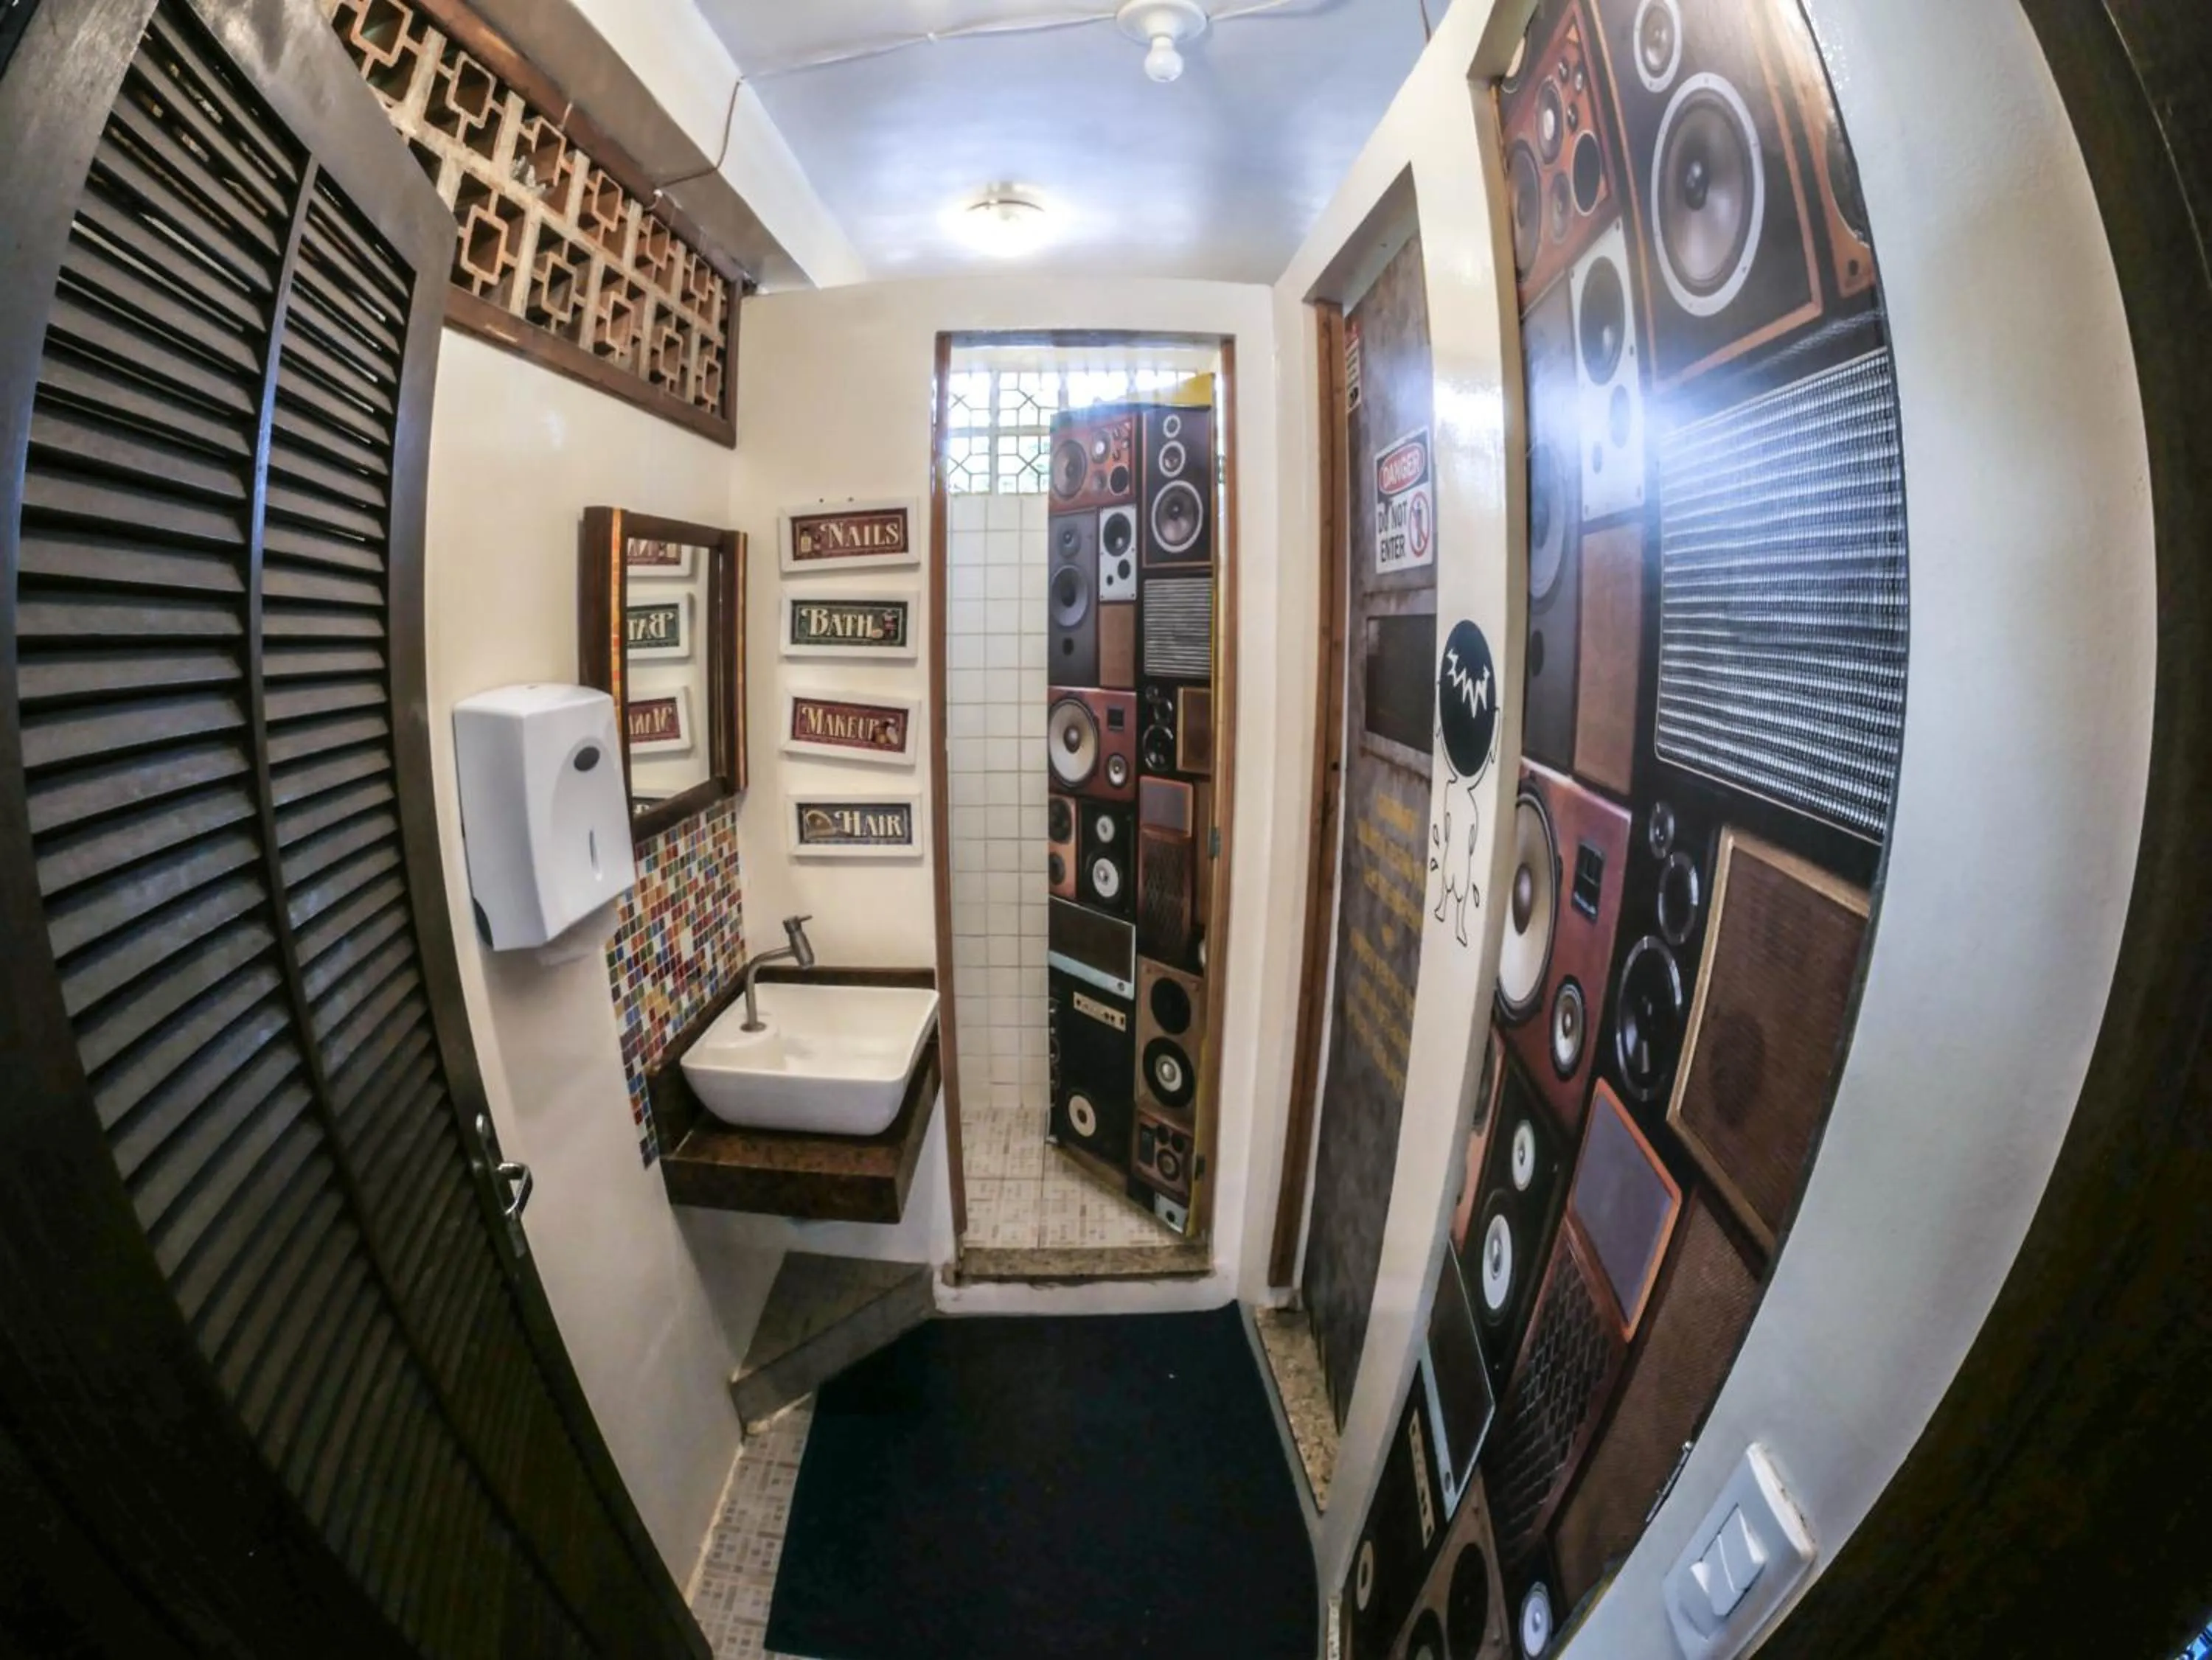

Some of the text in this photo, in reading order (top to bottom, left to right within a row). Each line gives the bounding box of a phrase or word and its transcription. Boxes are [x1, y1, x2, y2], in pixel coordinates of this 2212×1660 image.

[1382, 448, 1420, 489] DANGER
[1391, 501, 1408, 528] NOT
[820, 521, 900, 548] NAILS
[1380, 534, 1406, 562] ENTER
[801, 607, 874, 638] BATH
[801, 707, 880, 741] MAKEUP
[834, 811, 903, 837] HAIR
